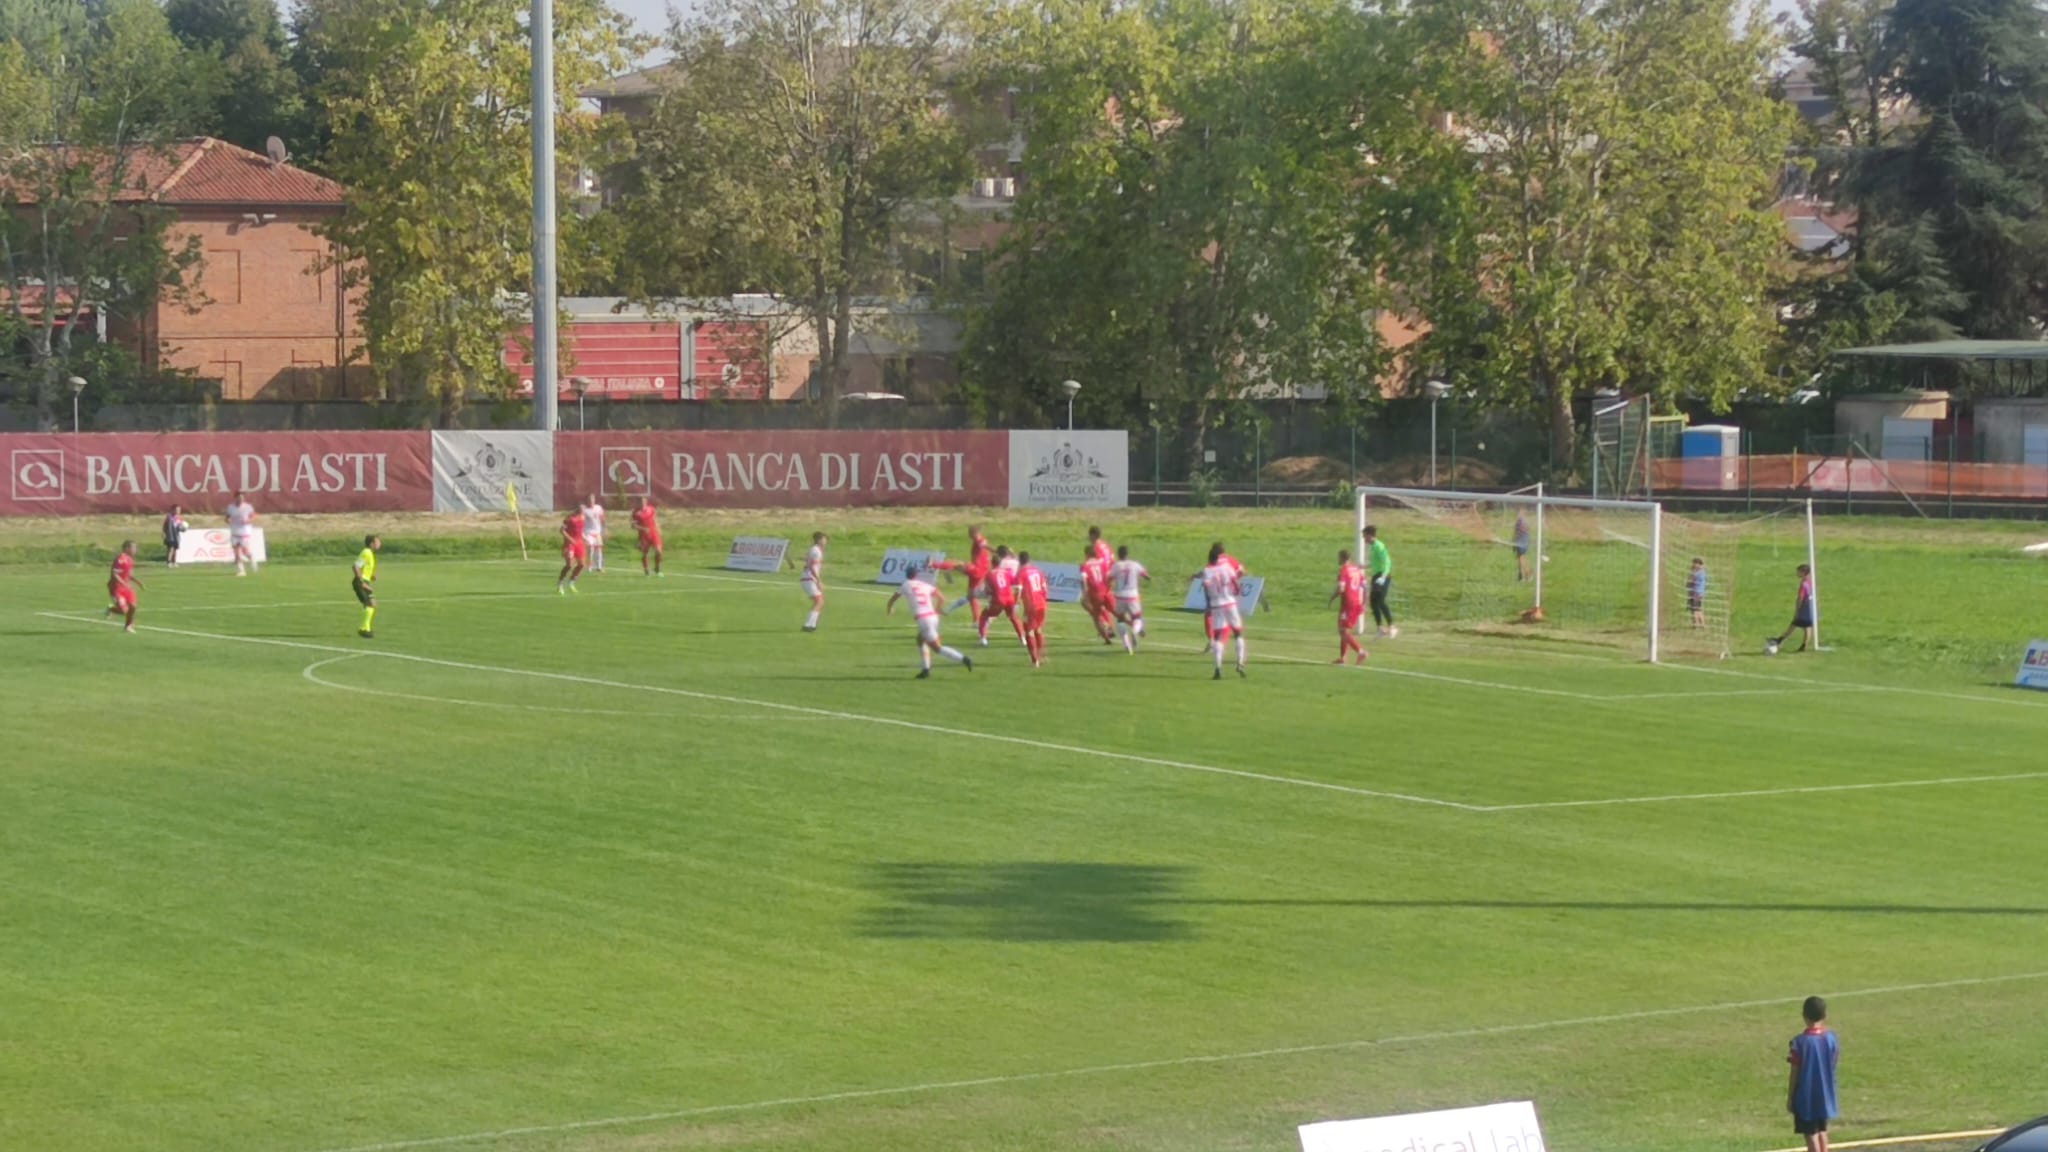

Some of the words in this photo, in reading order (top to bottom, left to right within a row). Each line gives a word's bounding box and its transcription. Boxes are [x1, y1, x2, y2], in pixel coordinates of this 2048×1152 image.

[86, 454, 226, 494] BANCA
[239, 453, 281, 492] DI
[291, 452, 388, 492] ASTI
[671, 453, 809, 492] BANCA
[820, 453, 860, 490] DI
[871, 452, 965, 490] ASTI
[1028, 482, 1109, 495] FONDAZIONE
